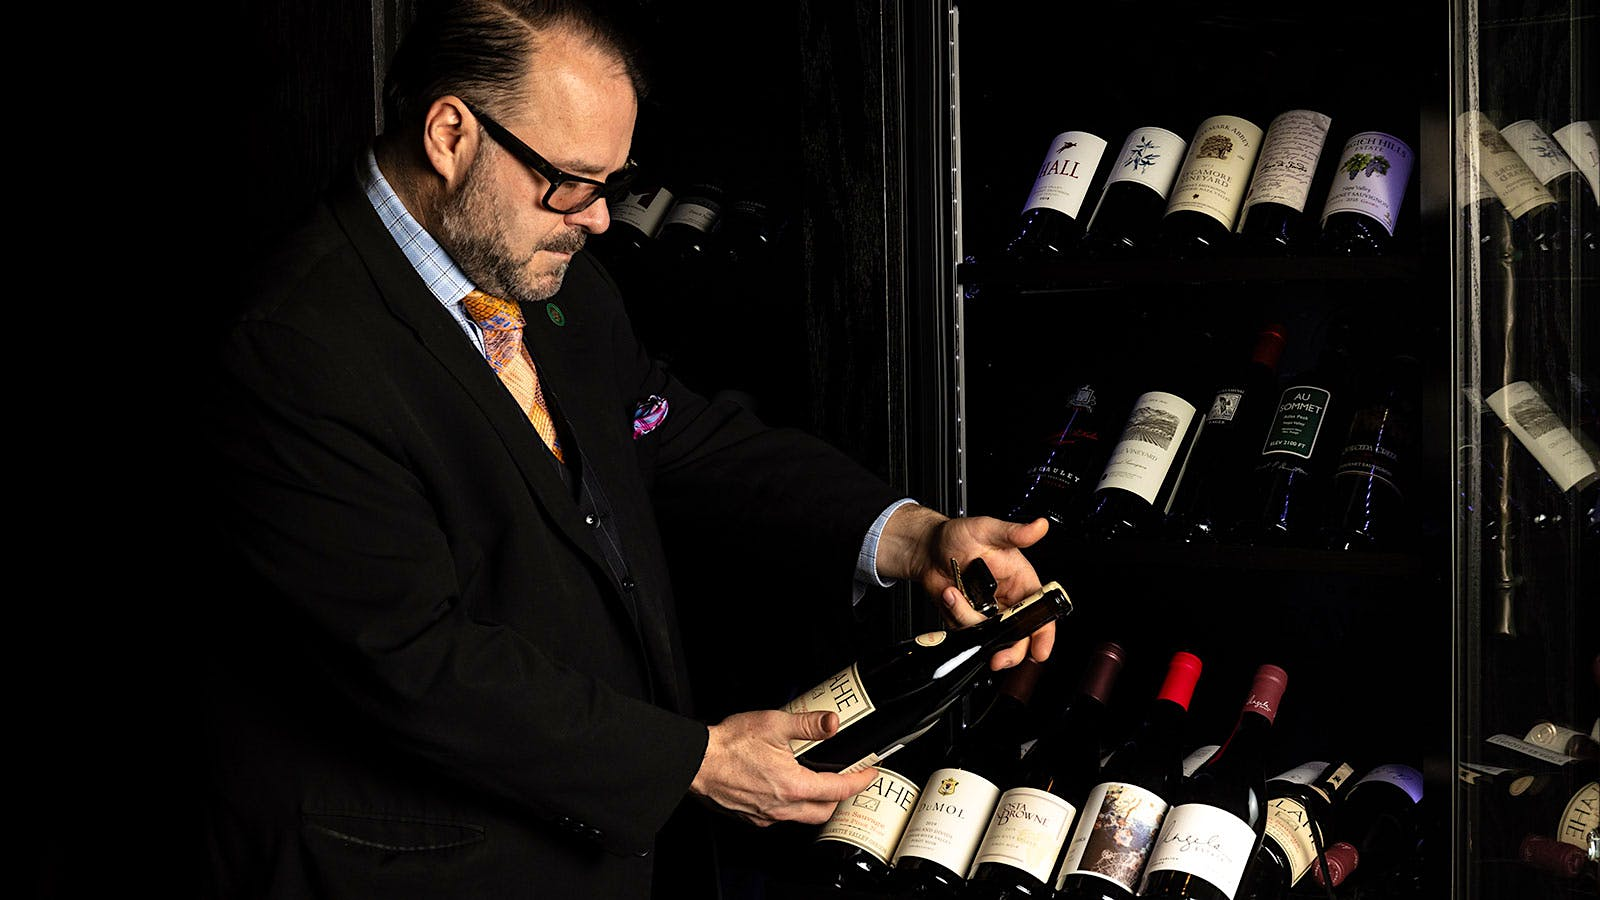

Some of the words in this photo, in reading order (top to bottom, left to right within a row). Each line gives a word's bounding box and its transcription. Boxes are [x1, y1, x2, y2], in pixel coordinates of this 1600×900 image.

[1231, 127, 1250, 148] ABBEY
[1378, 138, 1408, 158] HILLS
[1039, 159, 1081, 179] HALL
[1356, 185, 1371, 193] Valley
[1293, 392, 1311, 401] AU
[1279, 402, 1322, 414] SOMMET
[1282, 439, 1297, 447] 2100
[1126, 447, 1158, 462] VINEYARD
[1027, 466, 1080, 482] ACAULEY
[830, 673, 859, 713] AHE
[866, 776, 915, 812] AHE
[852, 810, 886, 829] Sauvage
[996, 808, 1049, 828] BROWNE
[849, 830, 869, 843] VALLEY
